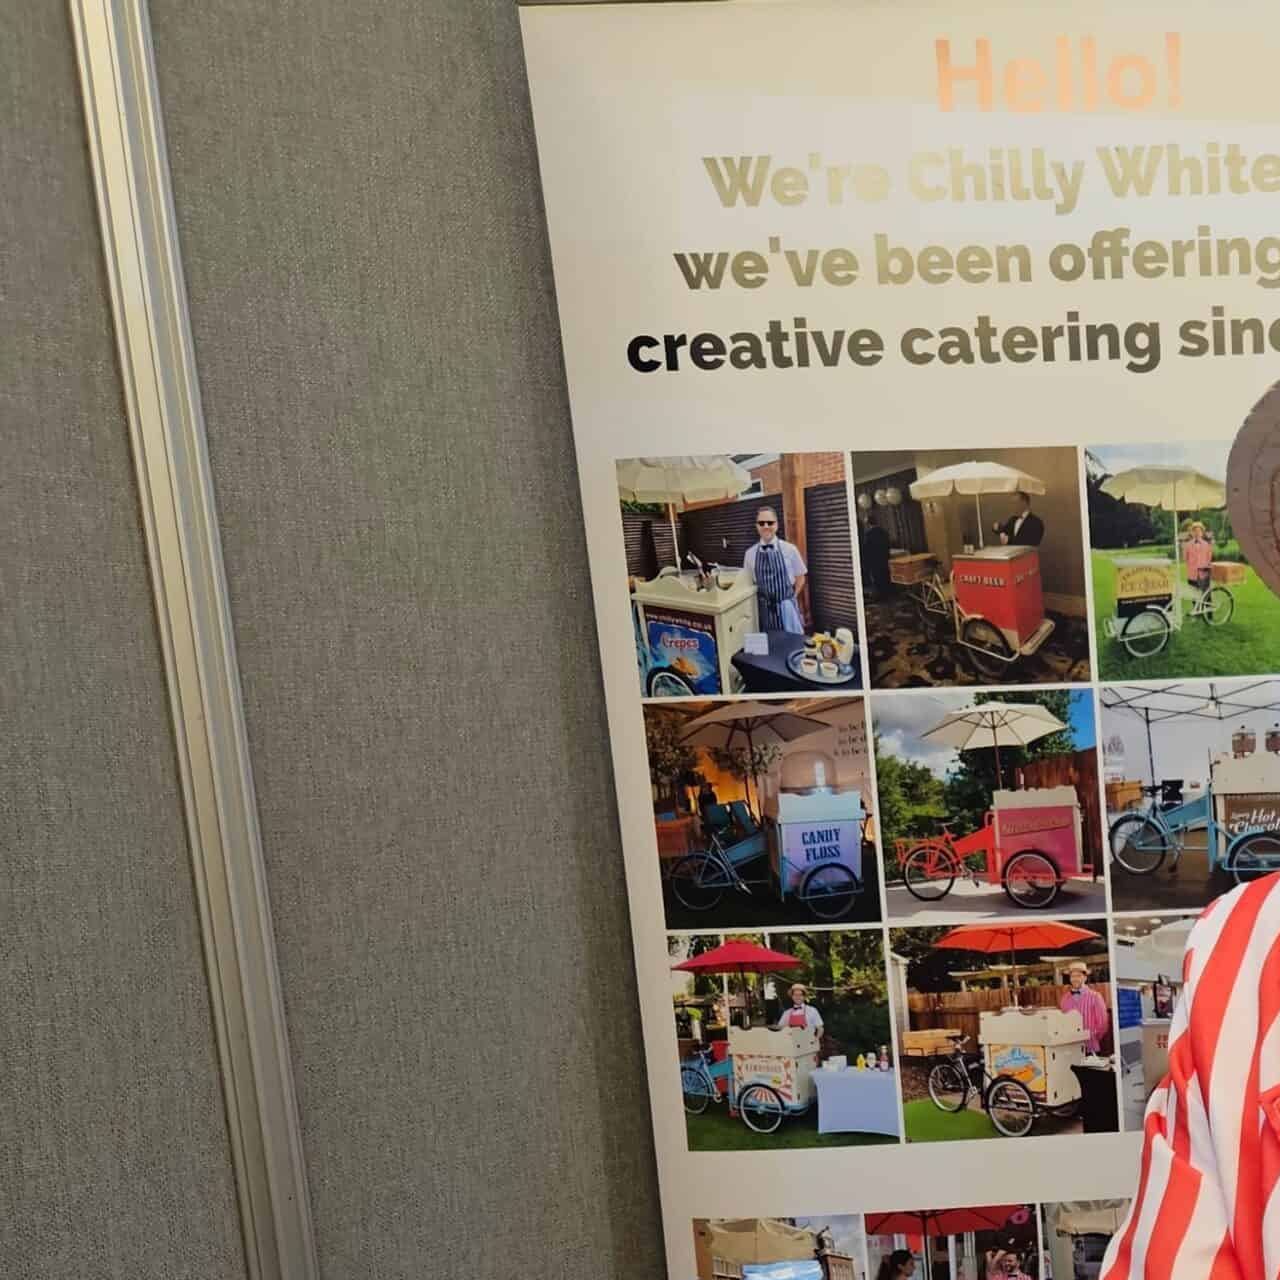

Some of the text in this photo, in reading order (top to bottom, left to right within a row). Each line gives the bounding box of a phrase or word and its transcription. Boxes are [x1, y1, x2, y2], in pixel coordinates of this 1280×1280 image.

[935, 32, 1183, 114] Hello!
[704, 152, 889, 209] We're
[909, 146, 1085, 215] Chilly
[674, 236, 860, 291] we've
[875, 233, 1033, 286] been
[627, 316, 885, 373] creative
[900, 309, 1161, 375] catering
[801, 828, 841, 846] CANDY
[1250, 808, 1276, 824] Hot
[805, 844, 841, 862] FLOSS
